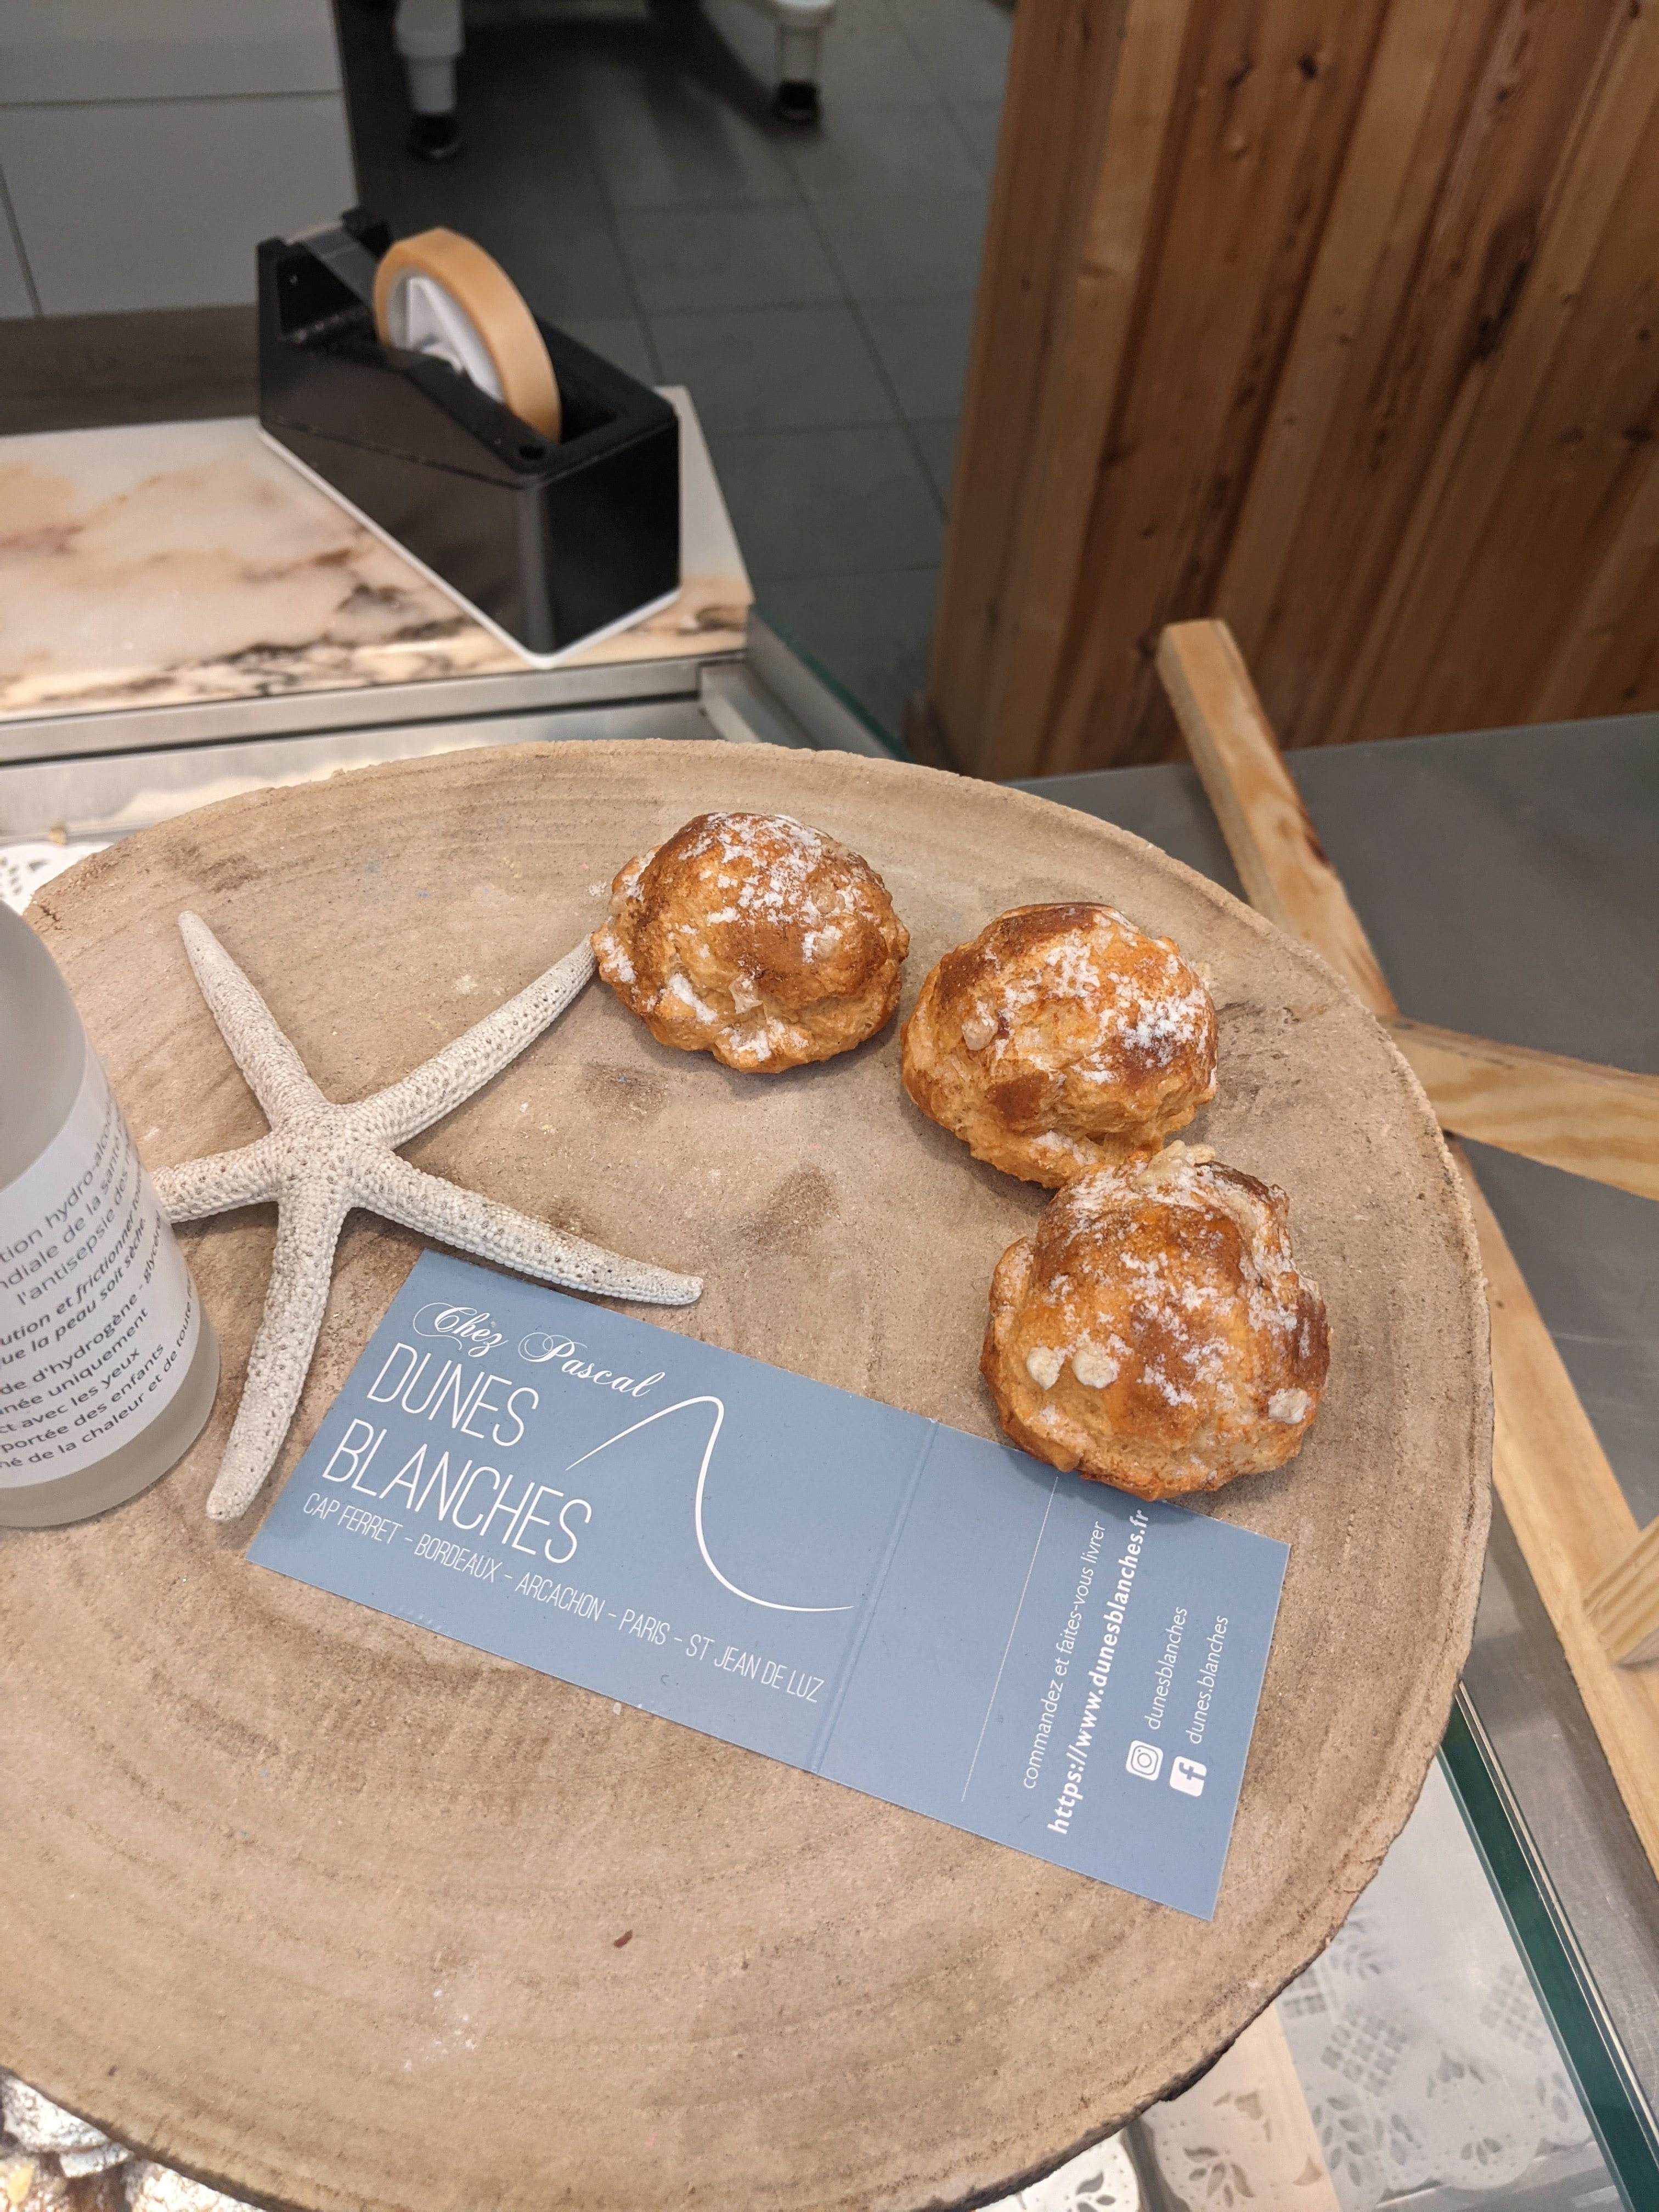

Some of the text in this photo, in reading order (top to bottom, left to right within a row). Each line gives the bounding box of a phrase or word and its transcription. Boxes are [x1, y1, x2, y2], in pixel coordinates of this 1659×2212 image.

[17, 1209, 115, 1305] l'antisepsie
[56, 1296, 74, 1314] et
[76, 1210, 133, 1304] frictionner
[63, 1218, 86, 1243] de
[86, 1196, 101, 1216] la
[0, 1307, 148, 1415] née uniquement
[31, 1336, 50, 1352] la
[55, 1300, 97, 1341] peau
[99, 1266, 124, 1301] soit
[32, 1293, 138, 1383] d'hydrogène
[413, 1302, 665, 1397] Chez Pascal
[1, 1344, 163, 1454] portée des enfants
[21, 1404, 69, 1429] avec
[70, 1386, 99, 1407] les
[101, 1347, 140, 1390] yeux
[28, 1450, 55, 1464] de
[57, 1441, 77, 1454] la
[82, 1392, 144, 1443] chaleur
[148, 1374, 163, 1392] et
[163, 1350, 178, 1373] de
[367, 1342, 539, 1447] DUNES
[322, 1418, 592, 1564] BLANCHES
[303, 1493, 340, 1520] CAP
[337, 1505, 403, 1544] FERRET
[414, 1533, 503, 1583] BORDEAUX
[515, 1571, 606, 1622] ARCACHON
[619, 1609, 670, 1645] PARIS
[686, 1634, 715, 1661] ST
[714, 1646, 761, 1680] JEAN
[761, 1660, 791, 1689] DE
[787, 1669, 824, 1703] LUZ
[1023, 1521, 1107, 1789] commandez et faites-vous livrer
[1047, 1509, 1149, 1834] https://www.dunesblanches.fr
[1143, 1606, 1187, 1730] dunesblanches
[1185, 1615, 1229, 1745] dunes.blanches
